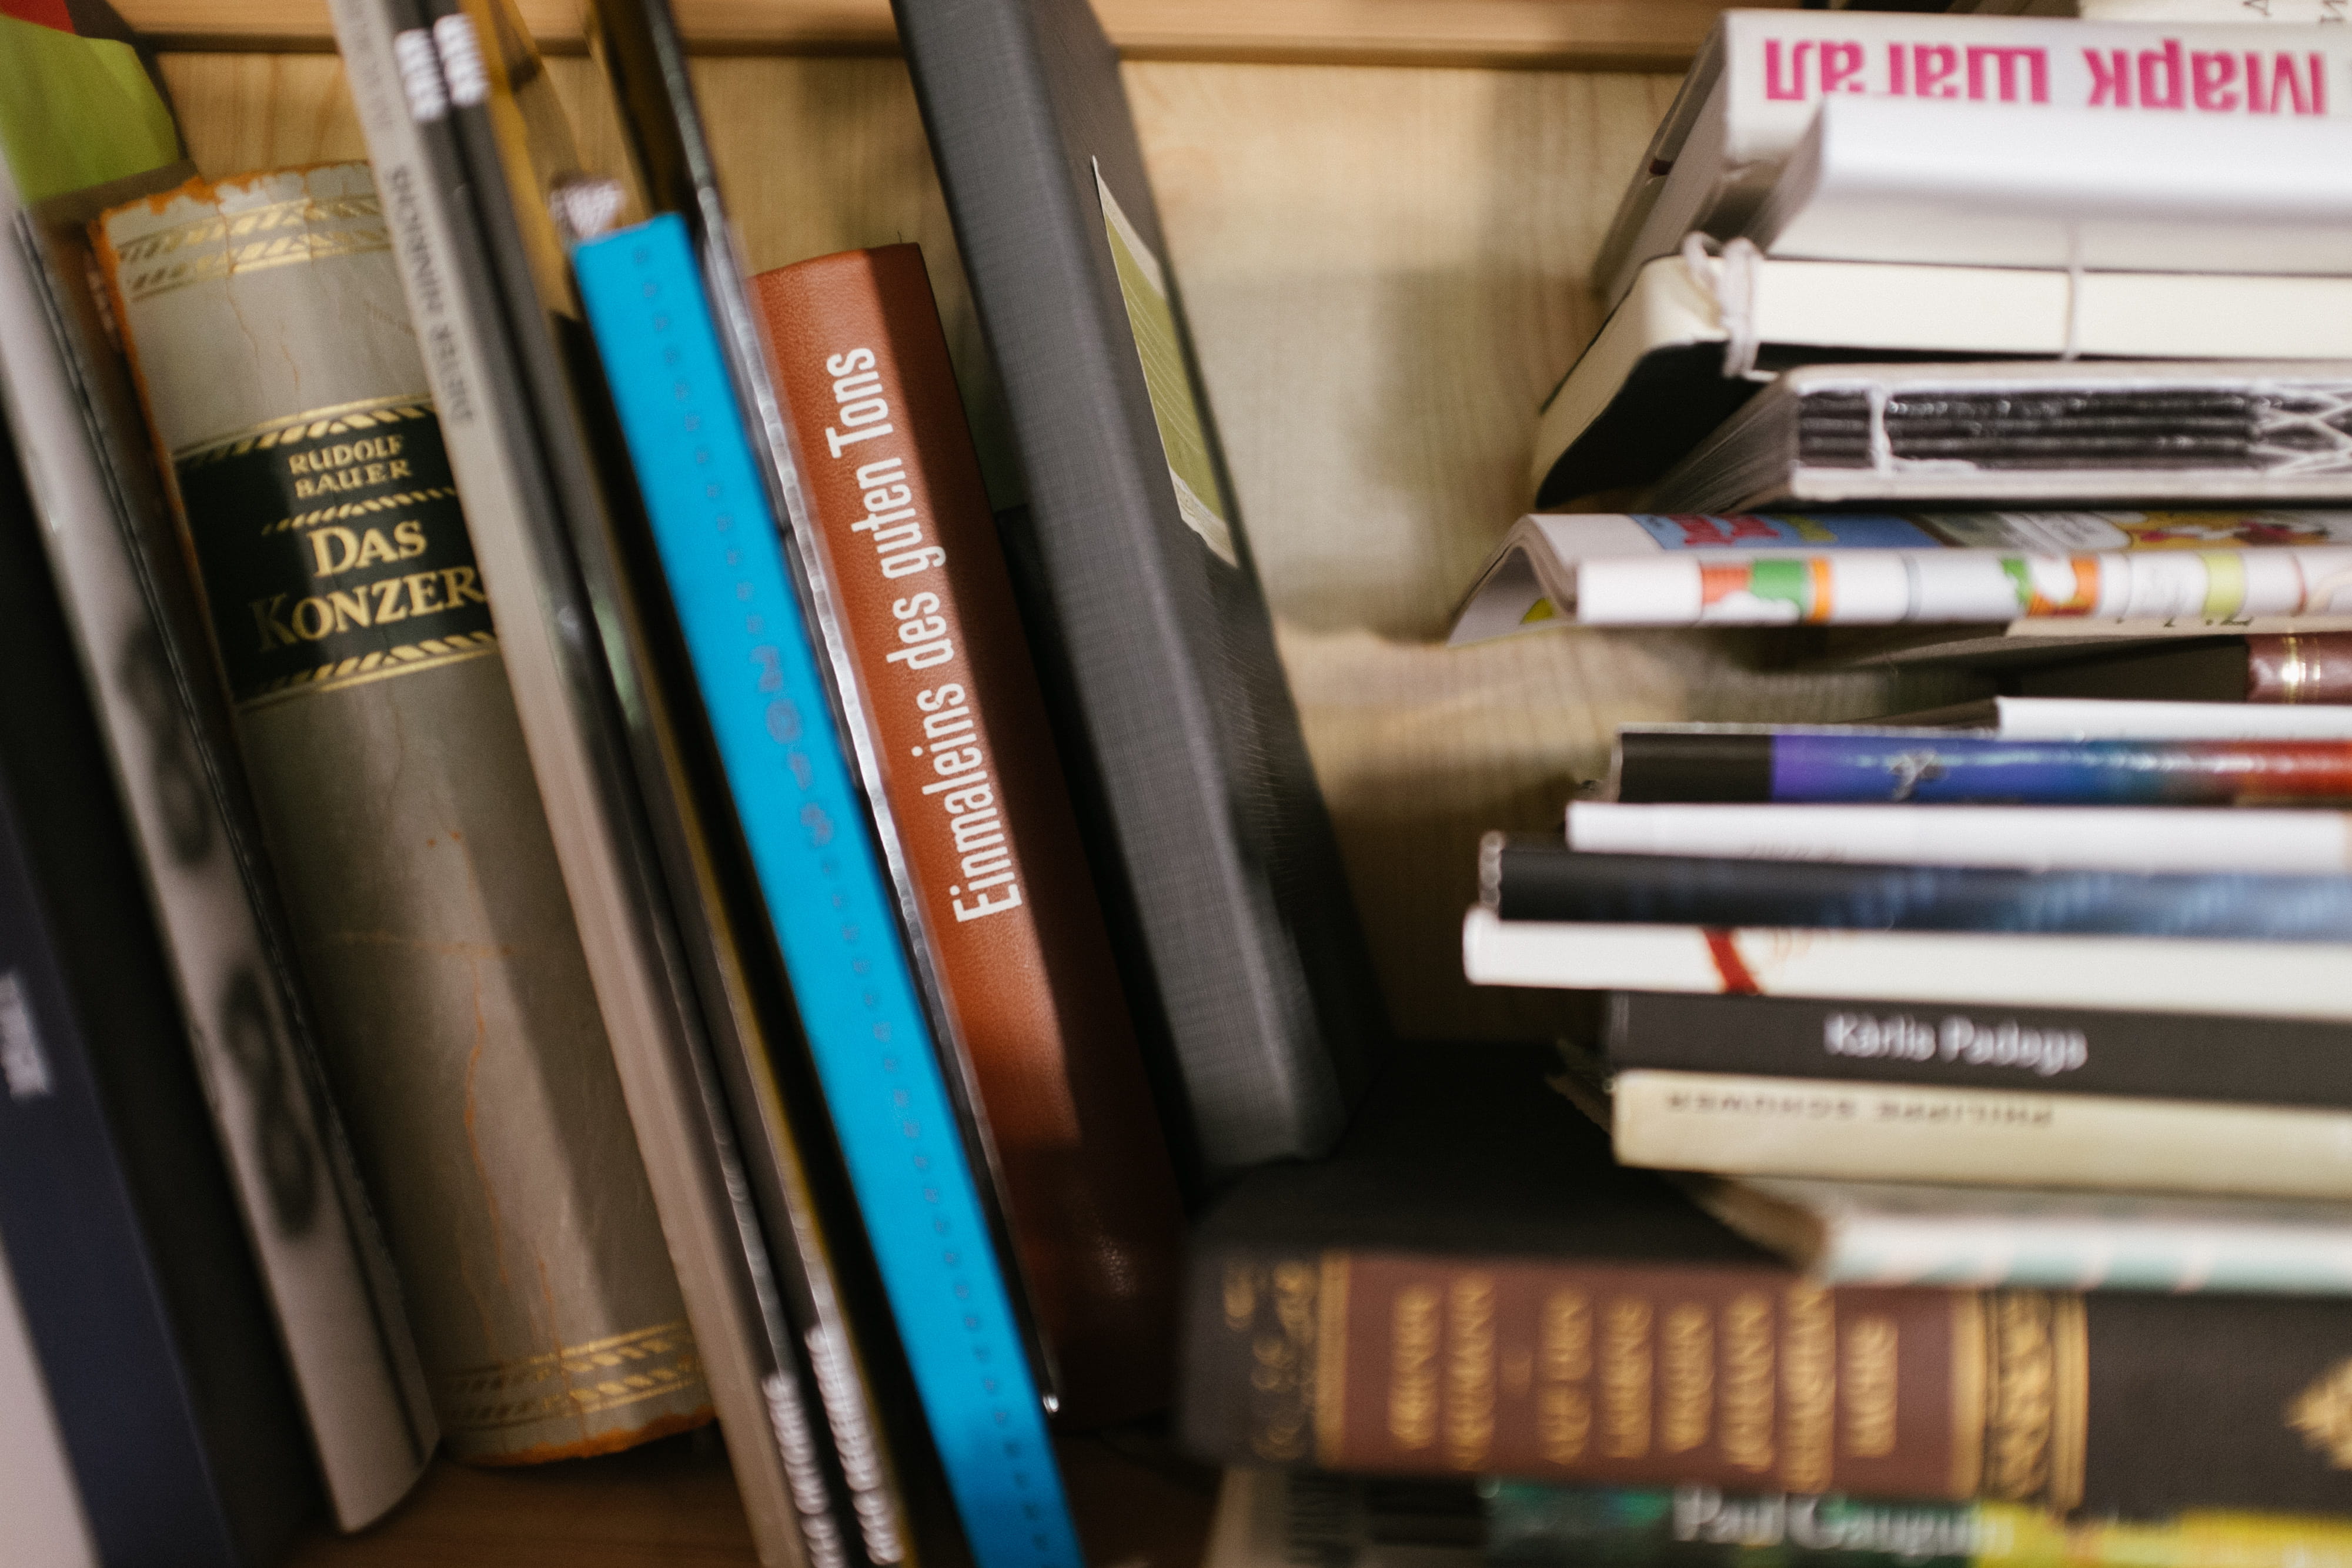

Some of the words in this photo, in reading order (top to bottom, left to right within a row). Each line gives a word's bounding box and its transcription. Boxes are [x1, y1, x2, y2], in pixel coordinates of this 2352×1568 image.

[826, 347, 895, 459] Tons
[288, 432, 405, 476] RUDOLF
[295, 458, 413, 500] BAUER
[308, 519, 428, 579] DAS
[851, 455, 946, 580] guten
[886, 591, 956, 670] des
[912, 682, 1023, 922] Einmaleins
